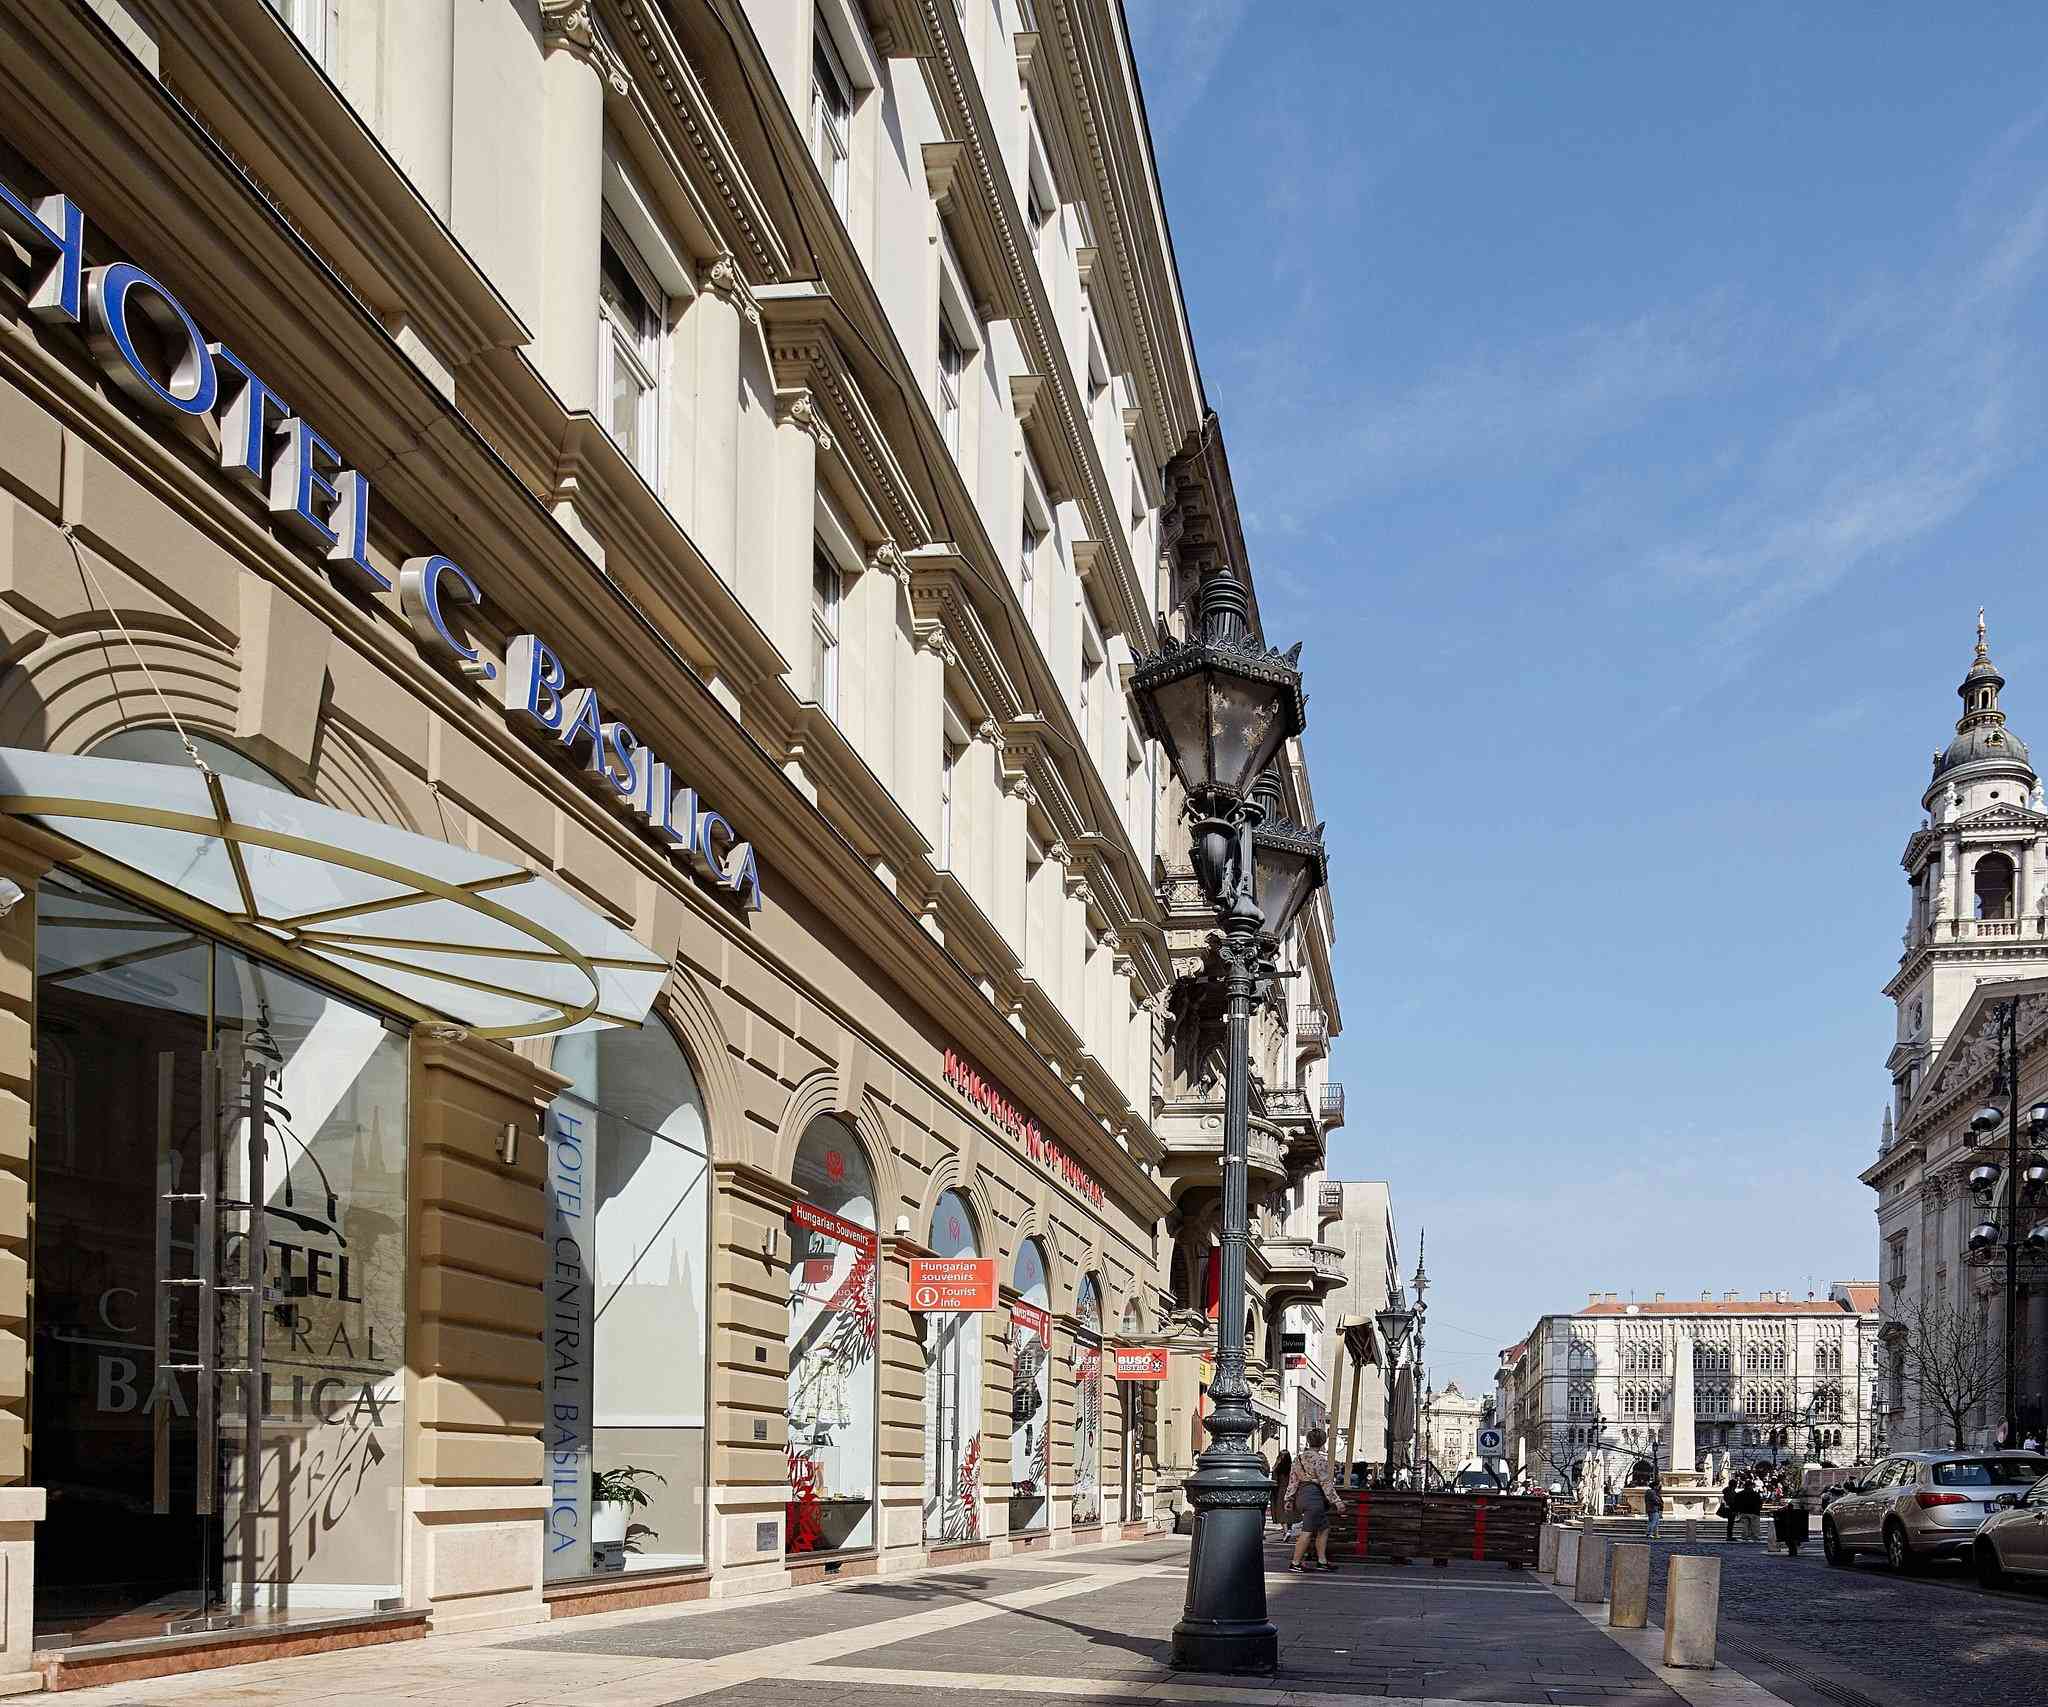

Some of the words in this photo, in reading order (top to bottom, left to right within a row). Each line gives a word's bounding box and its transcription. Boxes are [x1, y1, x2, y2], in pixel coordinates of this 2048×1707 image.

[514, 634, 763, 912] BASILICA
[943, 1047, 1025, 1136] MEMORIES
[1043, 1139, 1061, 1162] OF
[1061, 1154, 1106, 1207] HUNGARY
[557, 1112, 583, 1222] HOTEL
[796, 1205, 835, 1232] Hungarian
[836, 1222, 869, 1246] Souvenirs
[920, 1262, 977, 1273] Hungarian
[920, 1271, 977, 1281] souvenirs
[940, 1287, 977, 1296] Tourist
[940, 1298, 961, 1307] Info
[553, 1237, 582, 1390] CENTRAL
[552, 1403, 579, 1553] BASILICA
